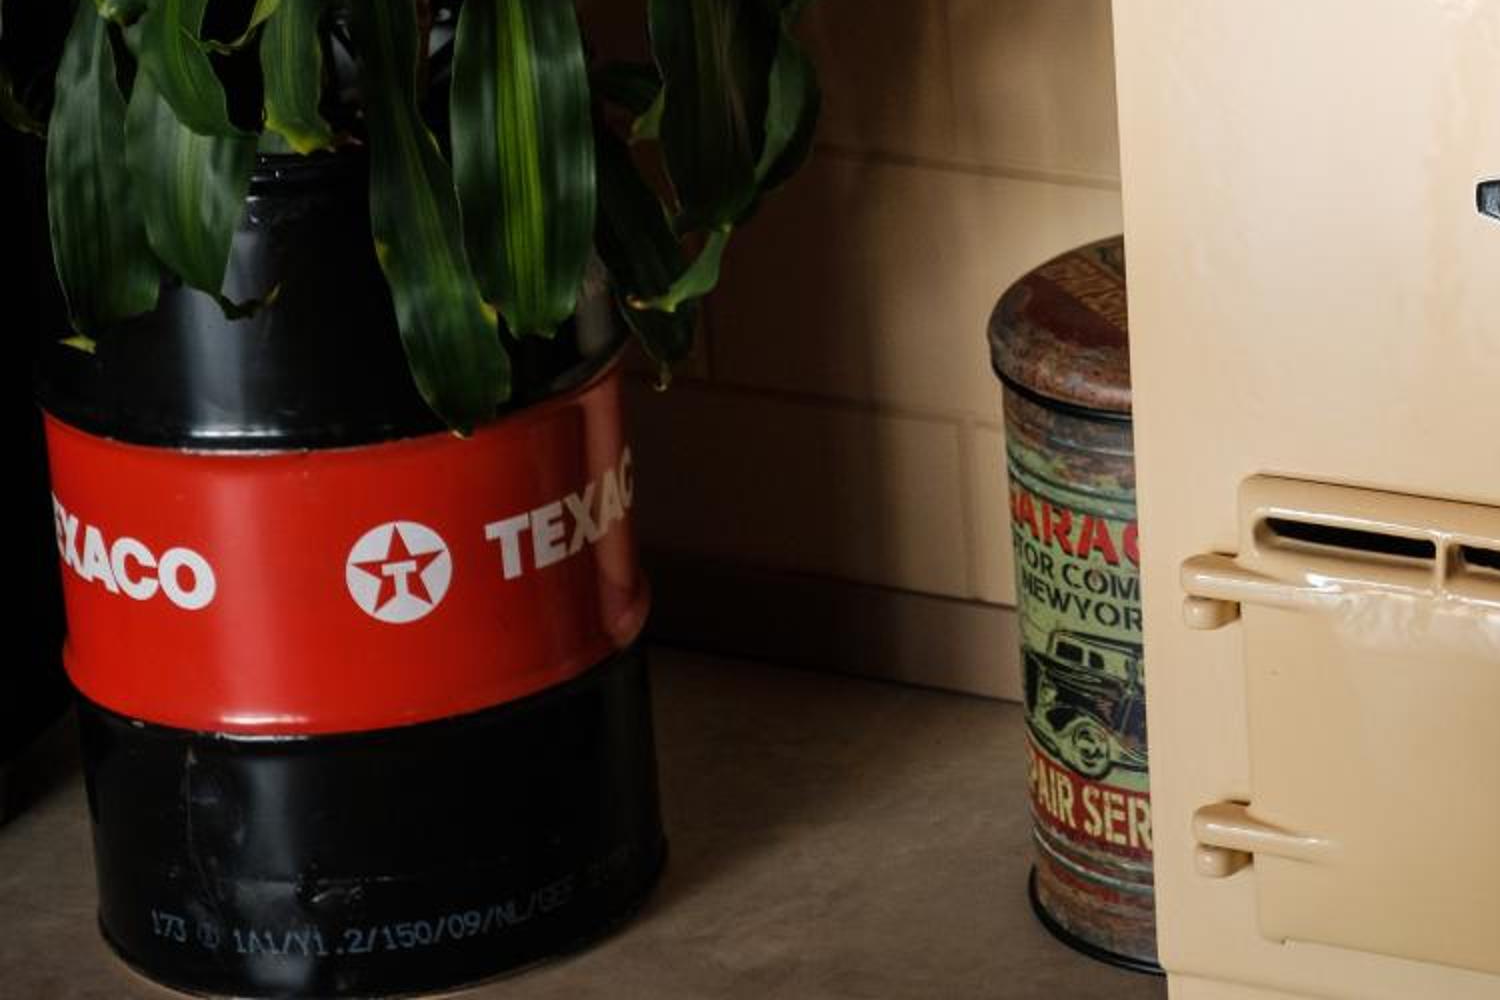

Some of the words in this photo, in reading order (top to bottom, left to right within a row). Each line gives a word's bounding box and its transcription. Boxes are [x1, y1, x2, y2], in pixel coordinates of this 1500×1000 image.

[52, 490, 217, 611] EXACO
[484, 445, 634, 581] TEXAC
[1010, 492, 1140, 577] ARA
[1014, 532, 1055, 581] TOR
[1062, 562, 1140, 602] COM
[1026, 758, 1077, 829] PAIR
[1082, 784, 1153, 850] SER
